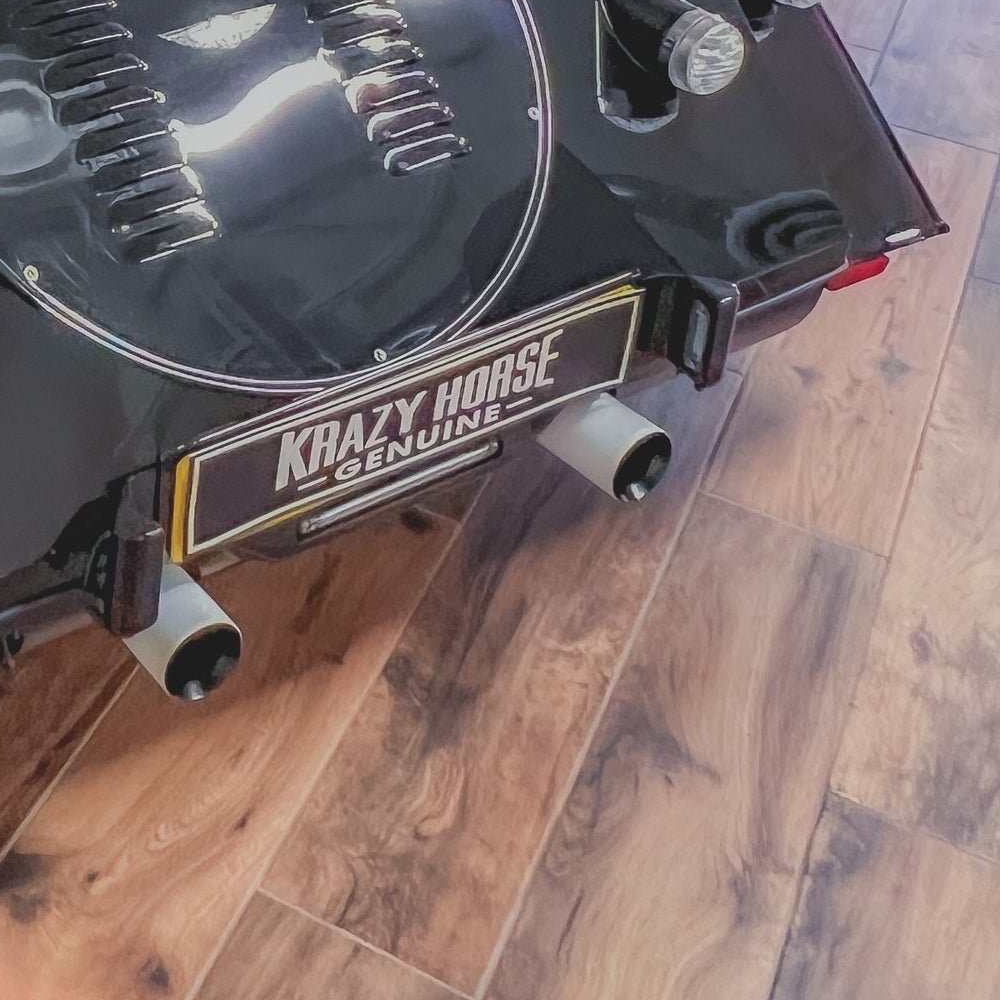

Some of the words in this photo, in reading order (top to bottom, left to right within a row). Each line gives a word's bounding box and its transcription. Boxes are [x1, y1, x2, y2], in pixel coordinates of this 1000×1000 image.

[275, 391, 427, 491] KRAZY
[433, 329, 563, 421] HORSE
[334, 404, 501, 481] GENUINE
